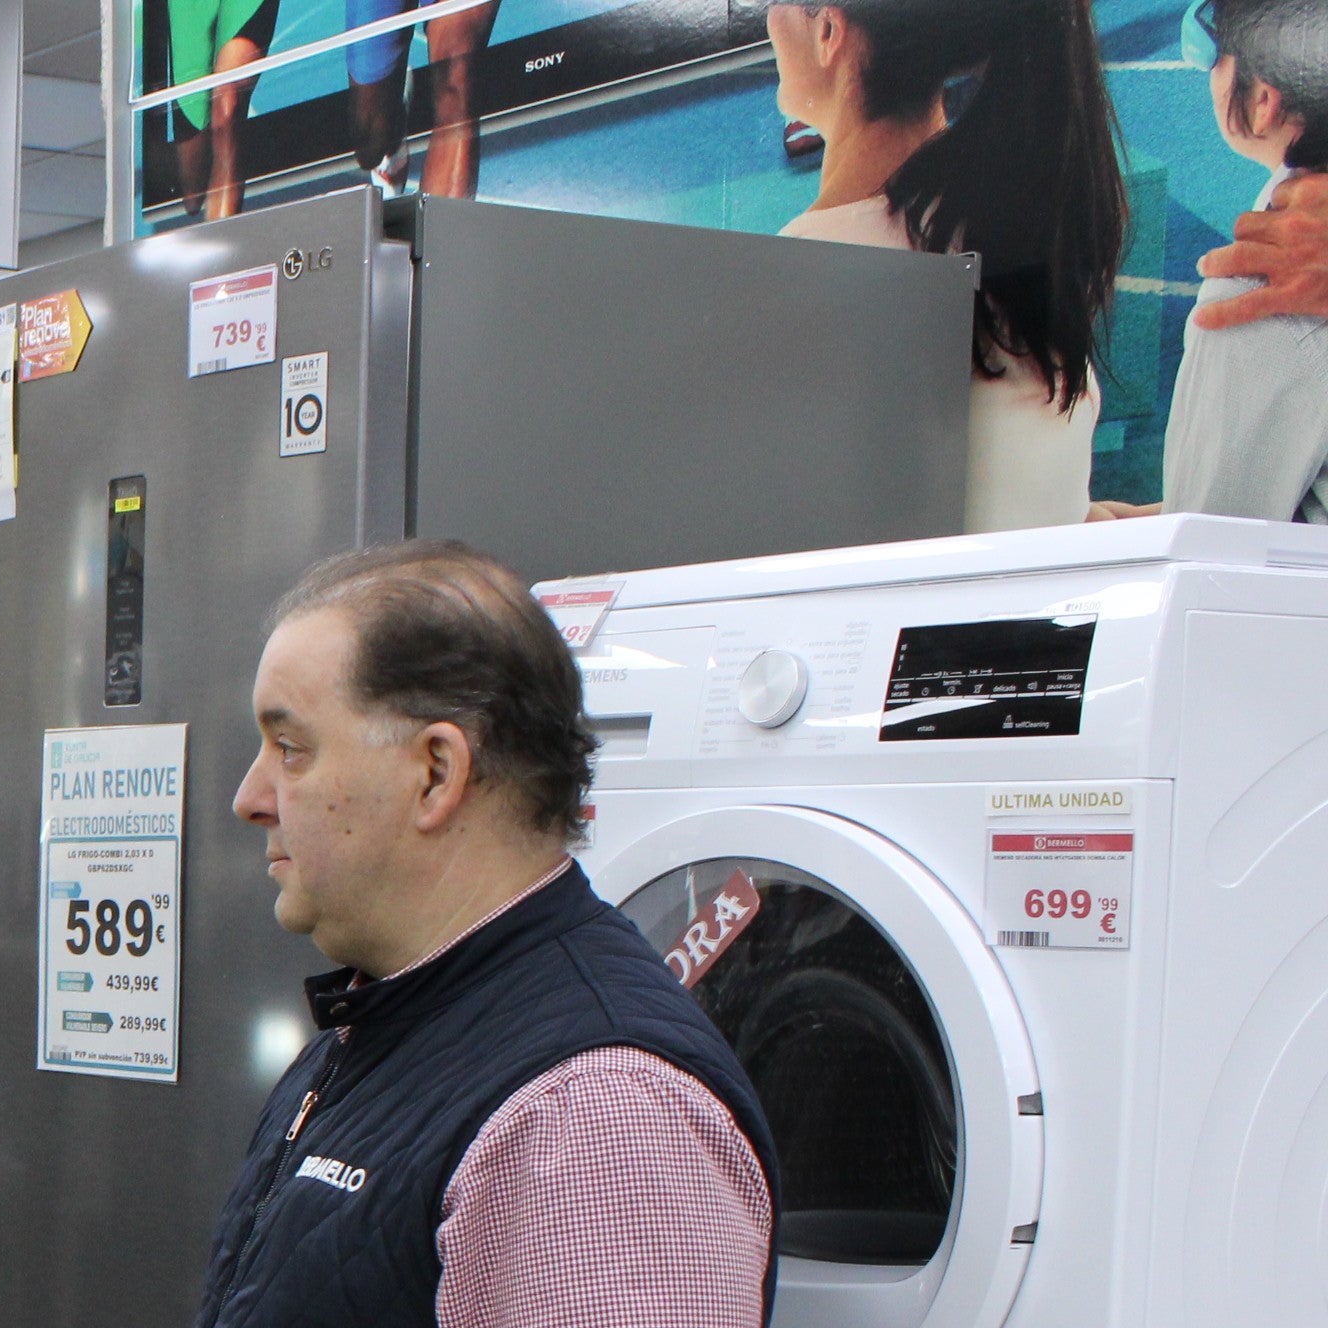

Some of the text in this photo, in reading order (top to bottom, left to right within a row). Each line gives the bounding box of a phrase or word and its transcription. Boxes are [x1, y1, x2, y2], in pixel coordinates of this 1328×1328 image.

[525, 52, 565, 73] SONY
[308, 246, 333, 273] LG
[213, 320, 251, 348] 739
[256, 335, 266, 351] €
[288, 358, 320, 373] SMART
[284, 394, 322, 438] 10
[301, 411, 315, 419] YEAR
[584, 669, 627, 684] EMENS
[993, 684, 1016, 692] delicado
[50, 767, 177, 800] PLAN RENOVE
[992, 792, 1123, 809] ULTIMA UNIDAD
[50, 810, 175, 836] ELECTRODOMÉSTICOS
[1047, 839, 1084, 847] BERMELLO
[68, 851, 77, 859] LG
[1024, 889, 1091, 918] 699
[1100, 913, 1116, 933] €
[66, 899, 153, 957] 589
[156, 925, 165, 943] €
[106, 975, 159, 993] 439,99€
[120, 1016, 166, 1034] 289,99€
